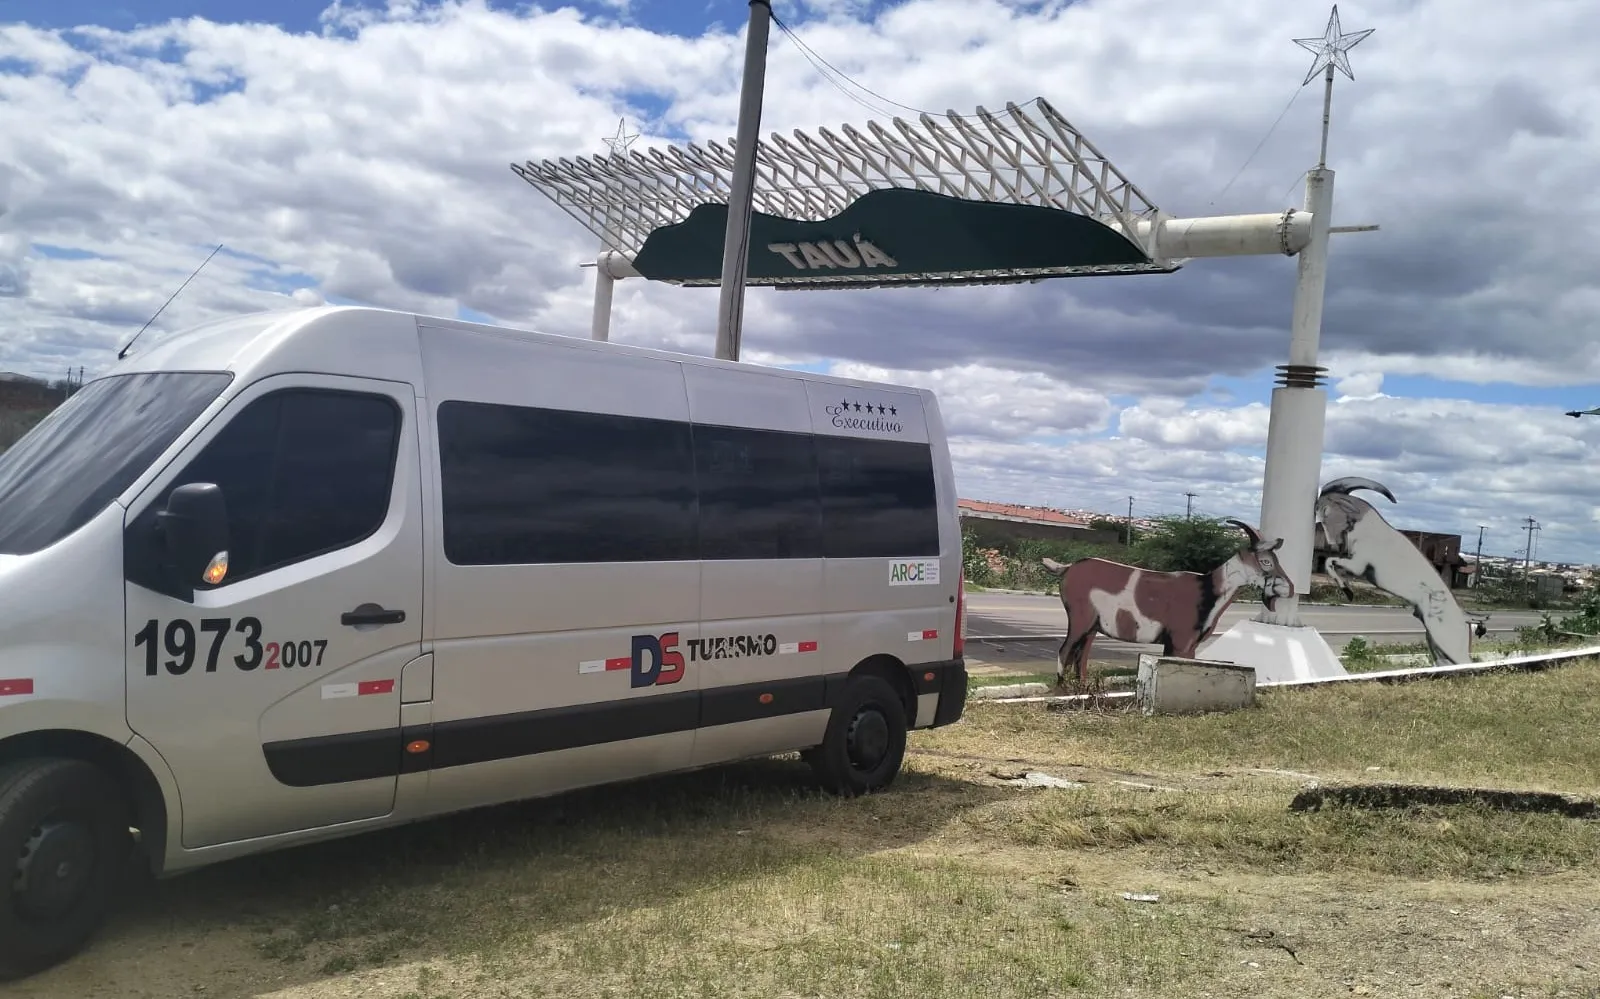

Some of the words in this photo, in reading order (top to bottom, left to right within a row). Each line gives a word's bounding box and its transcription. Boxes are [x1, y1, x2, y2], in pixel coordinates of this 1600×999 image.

[768, 232, 898, 269] TAUÁ
[891, 563, 924, 581] ARCE
[630, 632, 685, 689] DS
[687, 633, 776, 661] TURISMO
